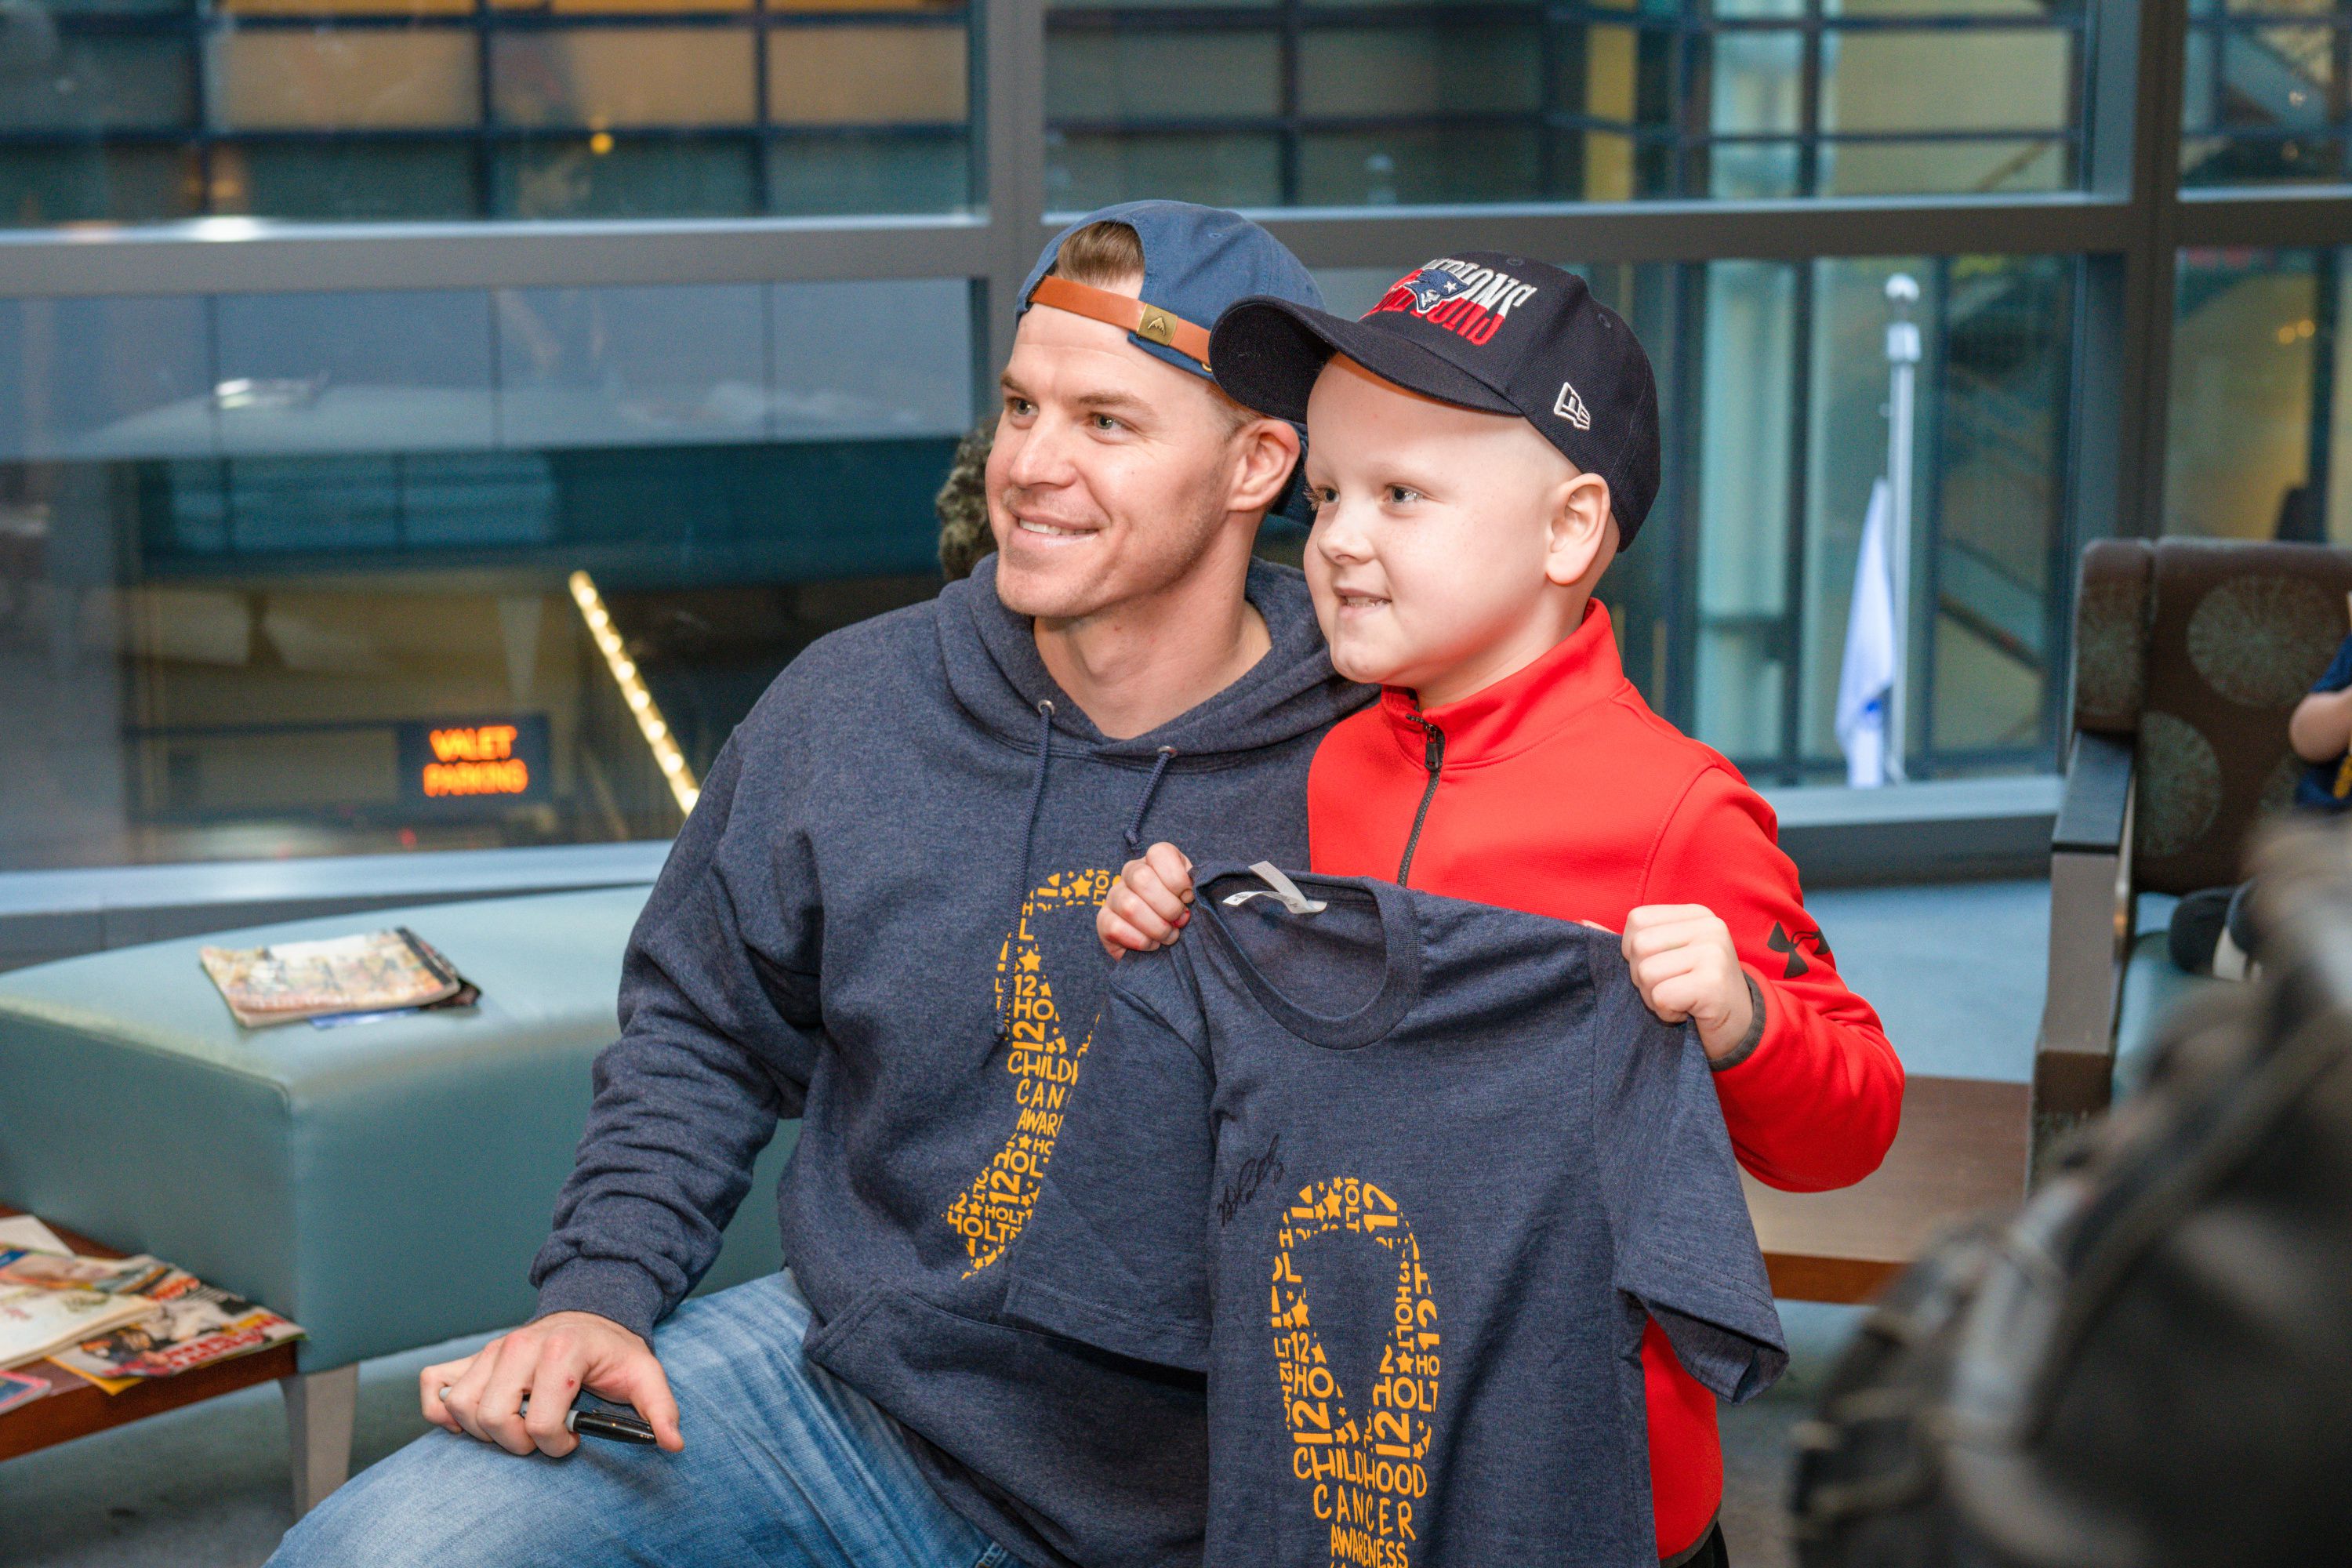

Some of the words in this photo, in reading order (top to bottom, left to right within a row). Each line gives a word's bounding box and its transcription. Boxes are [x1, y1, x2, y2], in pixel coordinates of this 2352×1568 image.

[430, 725, 517, 761] VALET
[423, 759, 528, 797] PARKING
[1294, 1446, 1427, 1497] CHILDHOOD
[1314, 1484, 1416, 1541] CANCER
[1330, 1525, 1408, 1568] AWARENESS
